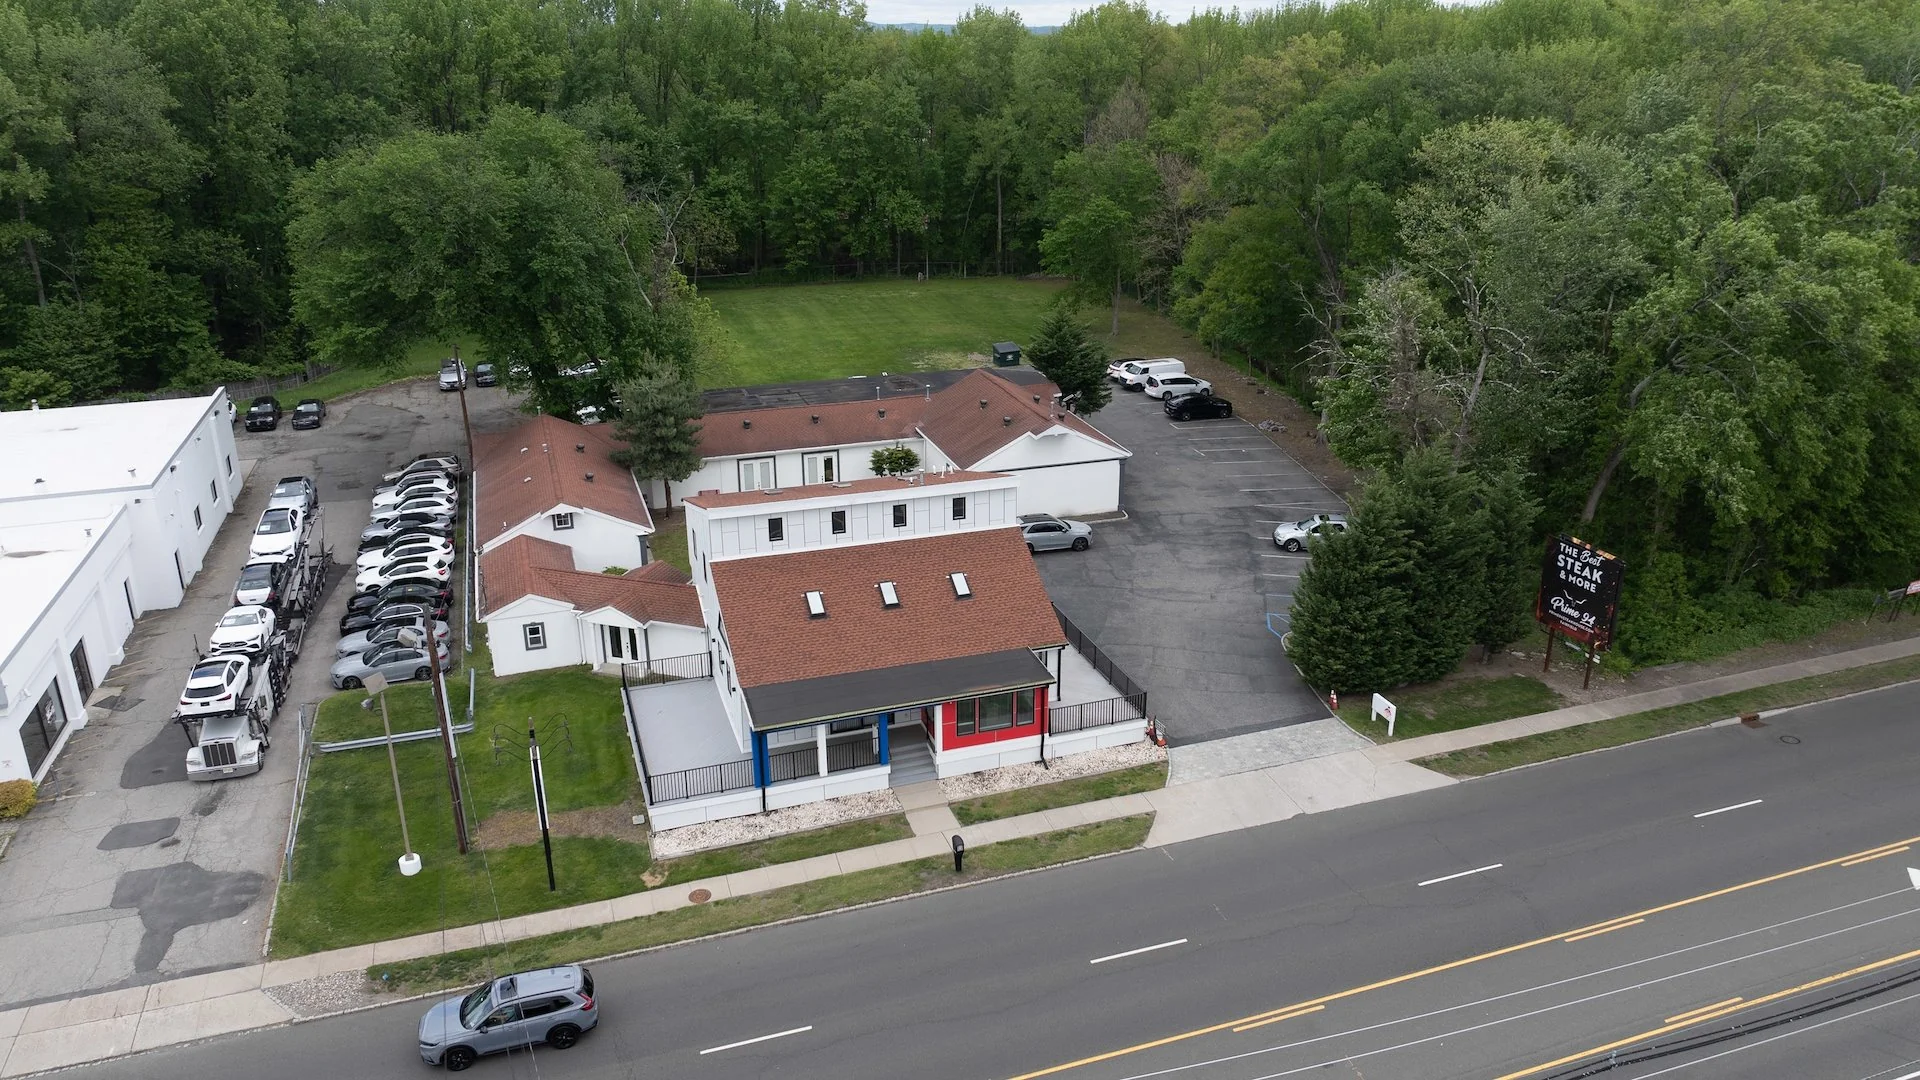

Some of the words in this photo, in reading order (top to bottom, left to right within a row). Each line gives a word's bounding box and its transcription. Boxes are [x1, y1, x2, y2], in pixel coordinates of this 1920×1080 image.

[1560, 543, 1578, 557] THE
[1580, 550, 1605, 567] Best
[1557, 554, 1603, 584] STEAK
[1559, 570, 1566, 580] &
[1568, 573, 1597, 593] MORE
[1550, 596, 1580, 618] Prime
[1581, 612, 1596, 626] 94
